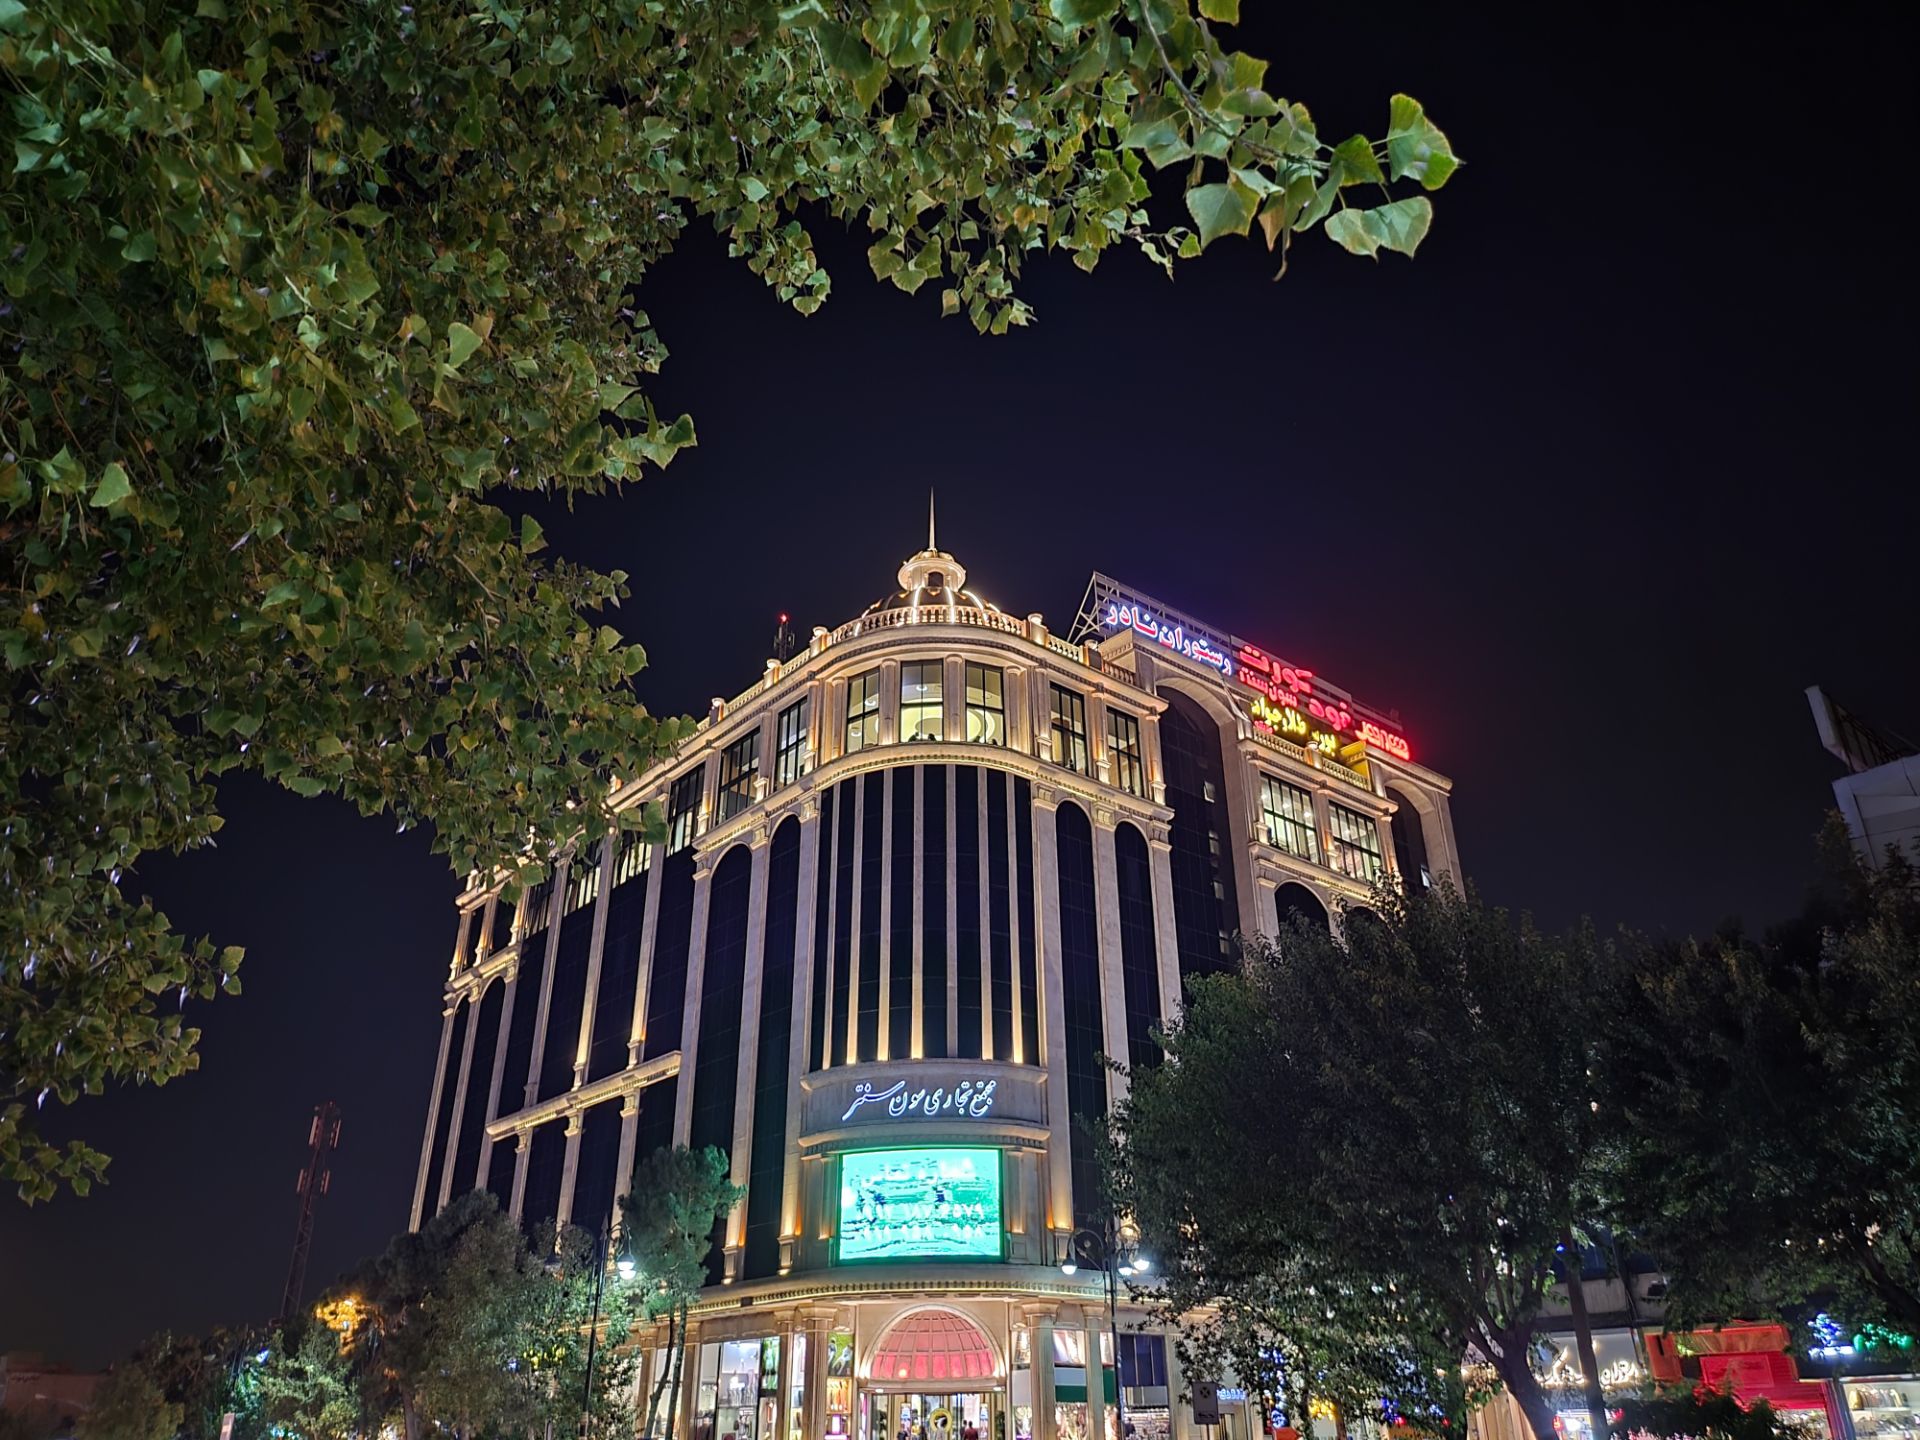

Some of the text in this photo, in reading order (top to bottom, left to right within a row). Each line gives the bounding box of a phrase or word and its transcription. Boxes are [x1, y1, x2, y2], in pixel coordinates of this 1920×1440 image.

[1105, 604, 1232, 676] رستوران نادر
[1239, 645, 1351, 731] فود کورت
[1250, 696, 1282, 731] جواه
[841, 1080, 996, 1121] مجتمع تجاری سون سنتر
